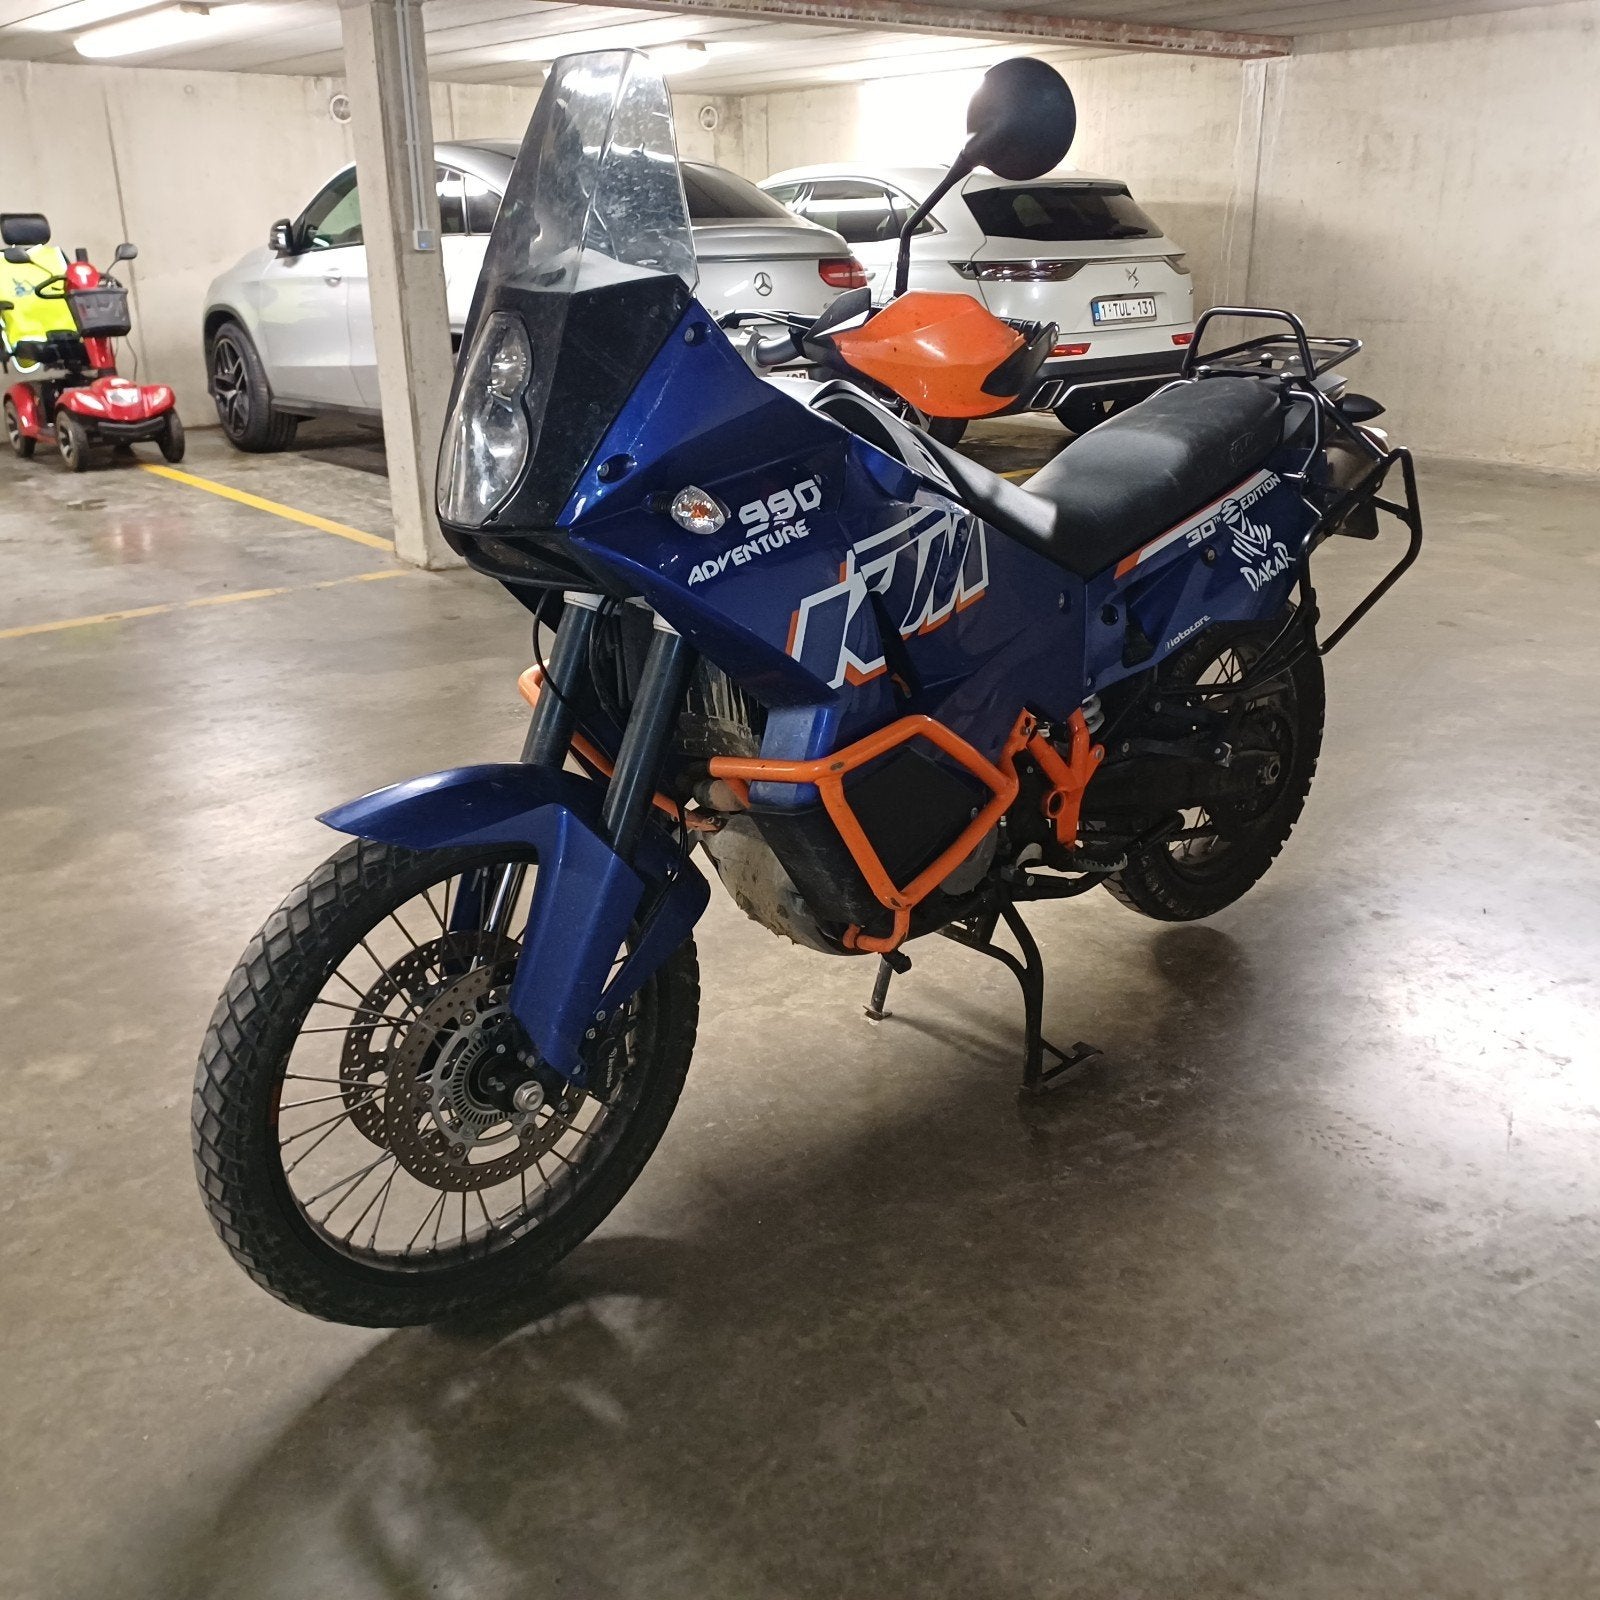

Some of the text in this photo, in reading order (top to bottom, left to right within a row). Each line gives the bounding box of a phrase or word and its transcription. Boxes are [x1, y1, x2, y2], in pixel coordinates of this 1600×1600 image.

[738, 479, 822, 538] 990
[1240, 473, 1281, 510] EDITION
[687, 518, 812, 588] ADVENTURE
[1240, 542, 1296, 592] DAKAR
[785, 506, 990, 690] KTM
